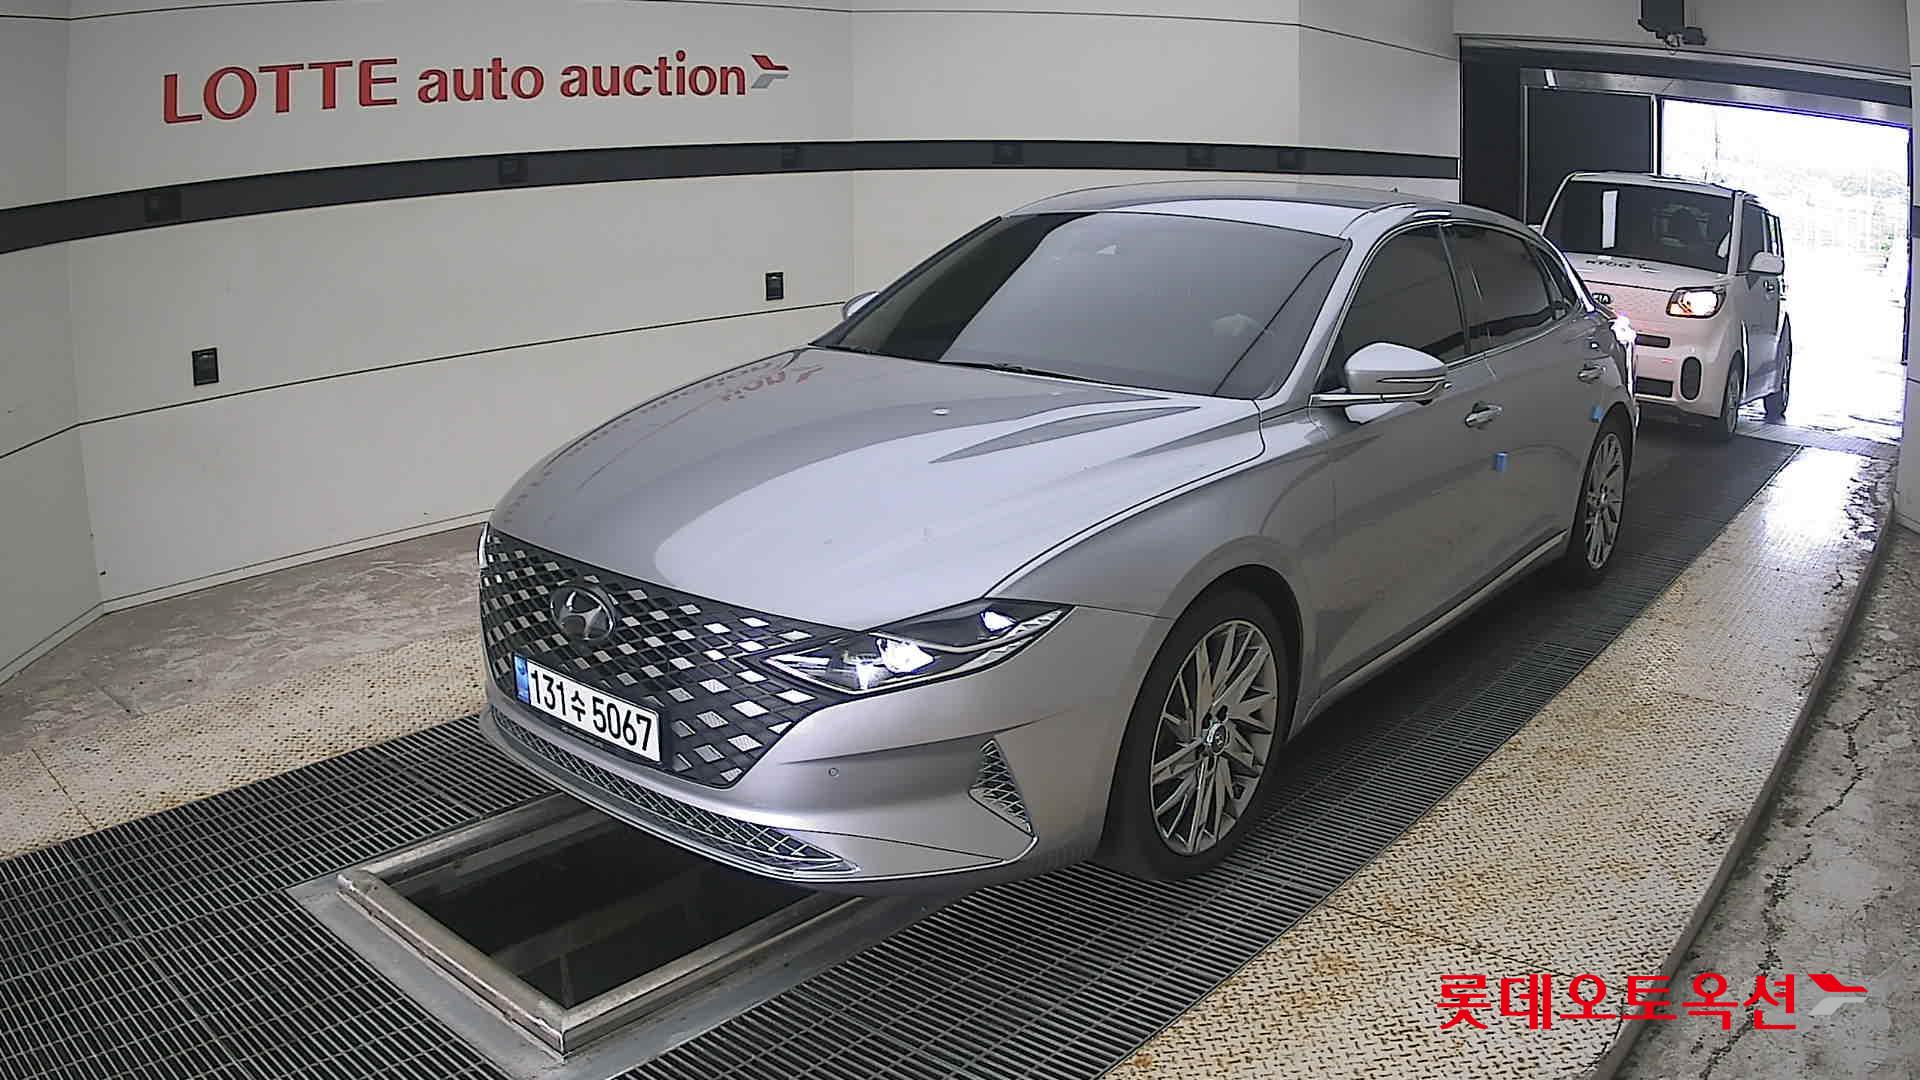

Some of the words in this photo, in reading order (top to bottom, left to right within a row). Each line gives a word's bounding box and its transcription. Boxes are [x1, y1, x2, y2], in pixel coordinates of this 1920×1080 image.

[163, 58, 398, 124] LOTTE
[417, 57, 544, 103] auto
[560, 50, 746, 97] auction
[531, 670, 586, 722] 131수
[592, 695, 652, 751] 5067
